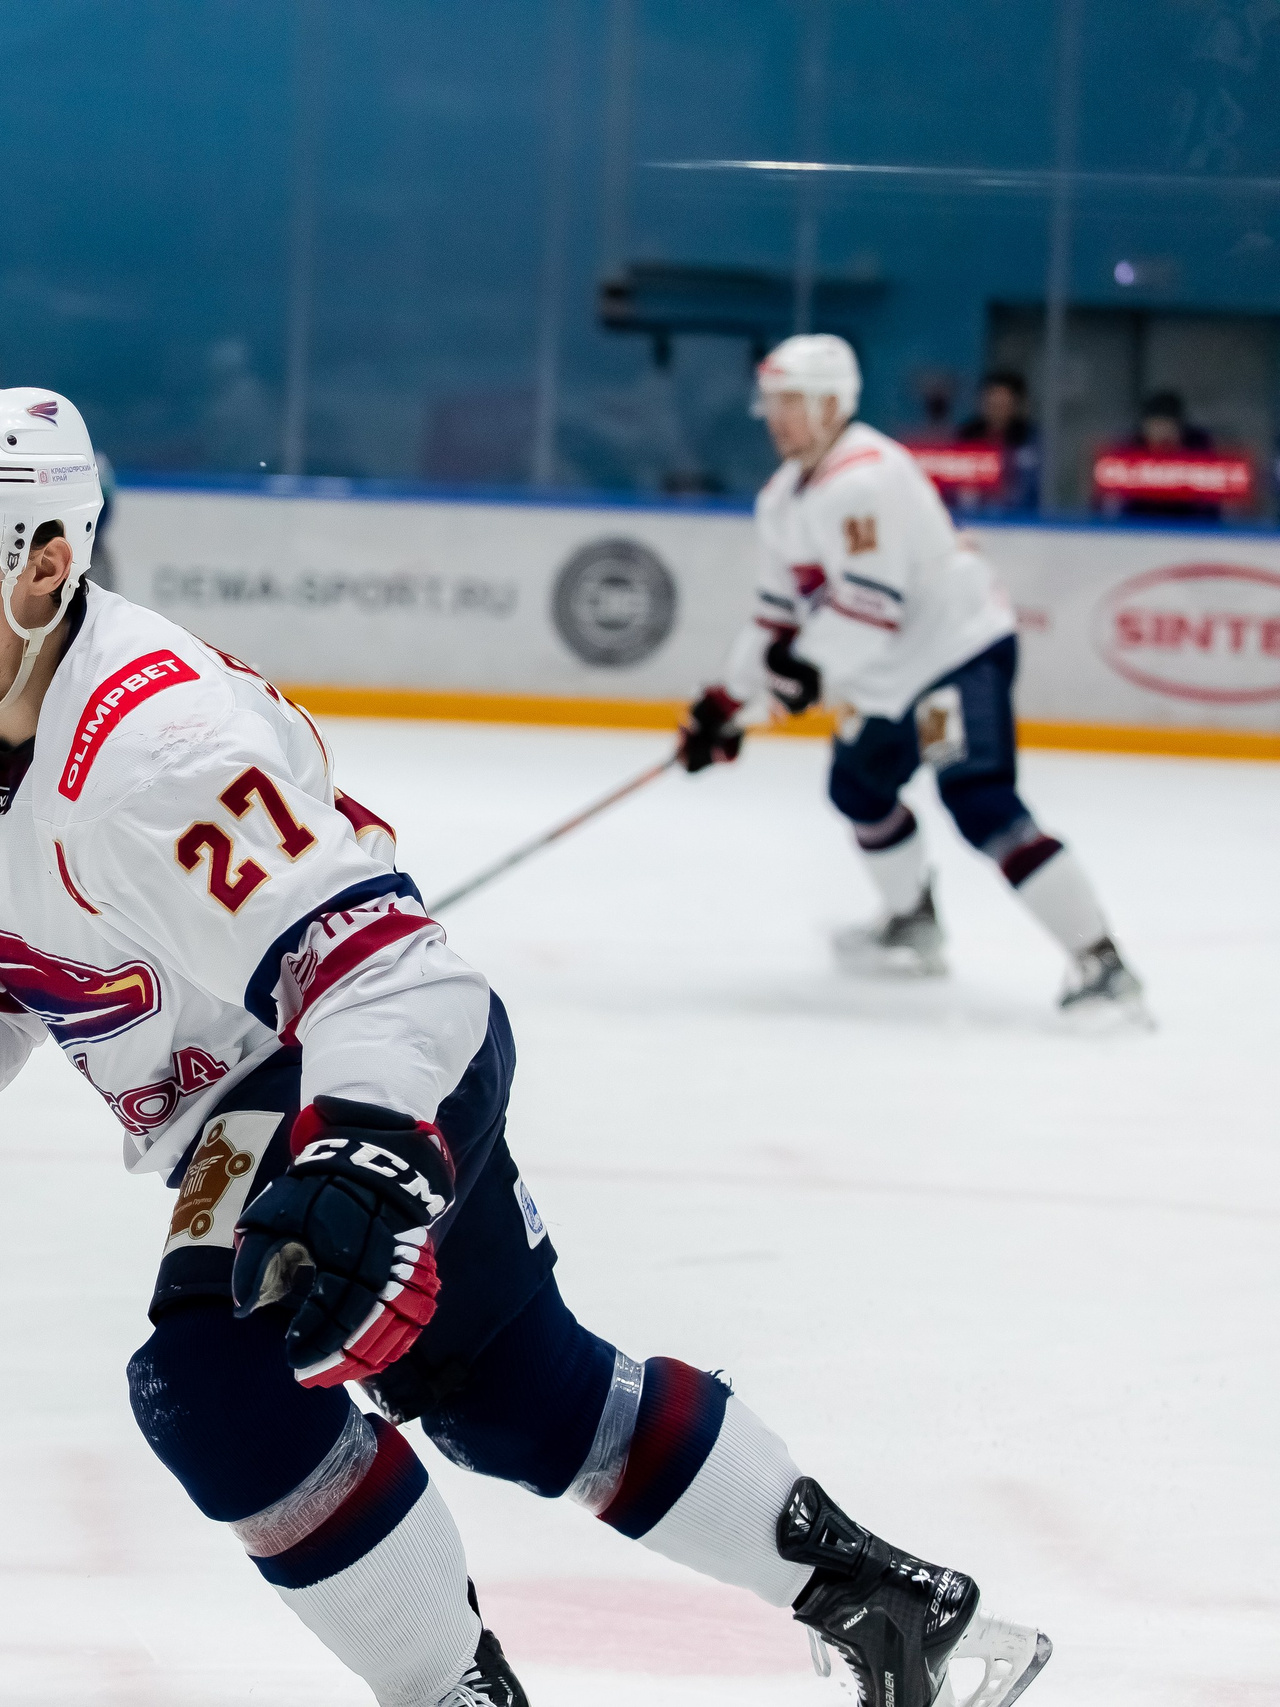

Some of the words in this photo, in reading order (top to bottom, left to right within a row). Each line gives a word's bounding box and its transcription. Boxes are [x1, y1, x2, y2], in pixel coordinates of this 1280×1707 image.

[52, 473, 68, 482] КРАЙ
[66, 658, 180, 789] OLIMPBET
[175, 764, 318, 917] 27
[294, 1138, 446, 1218] CCM
[842, 1606, 868, 1631] MACH
